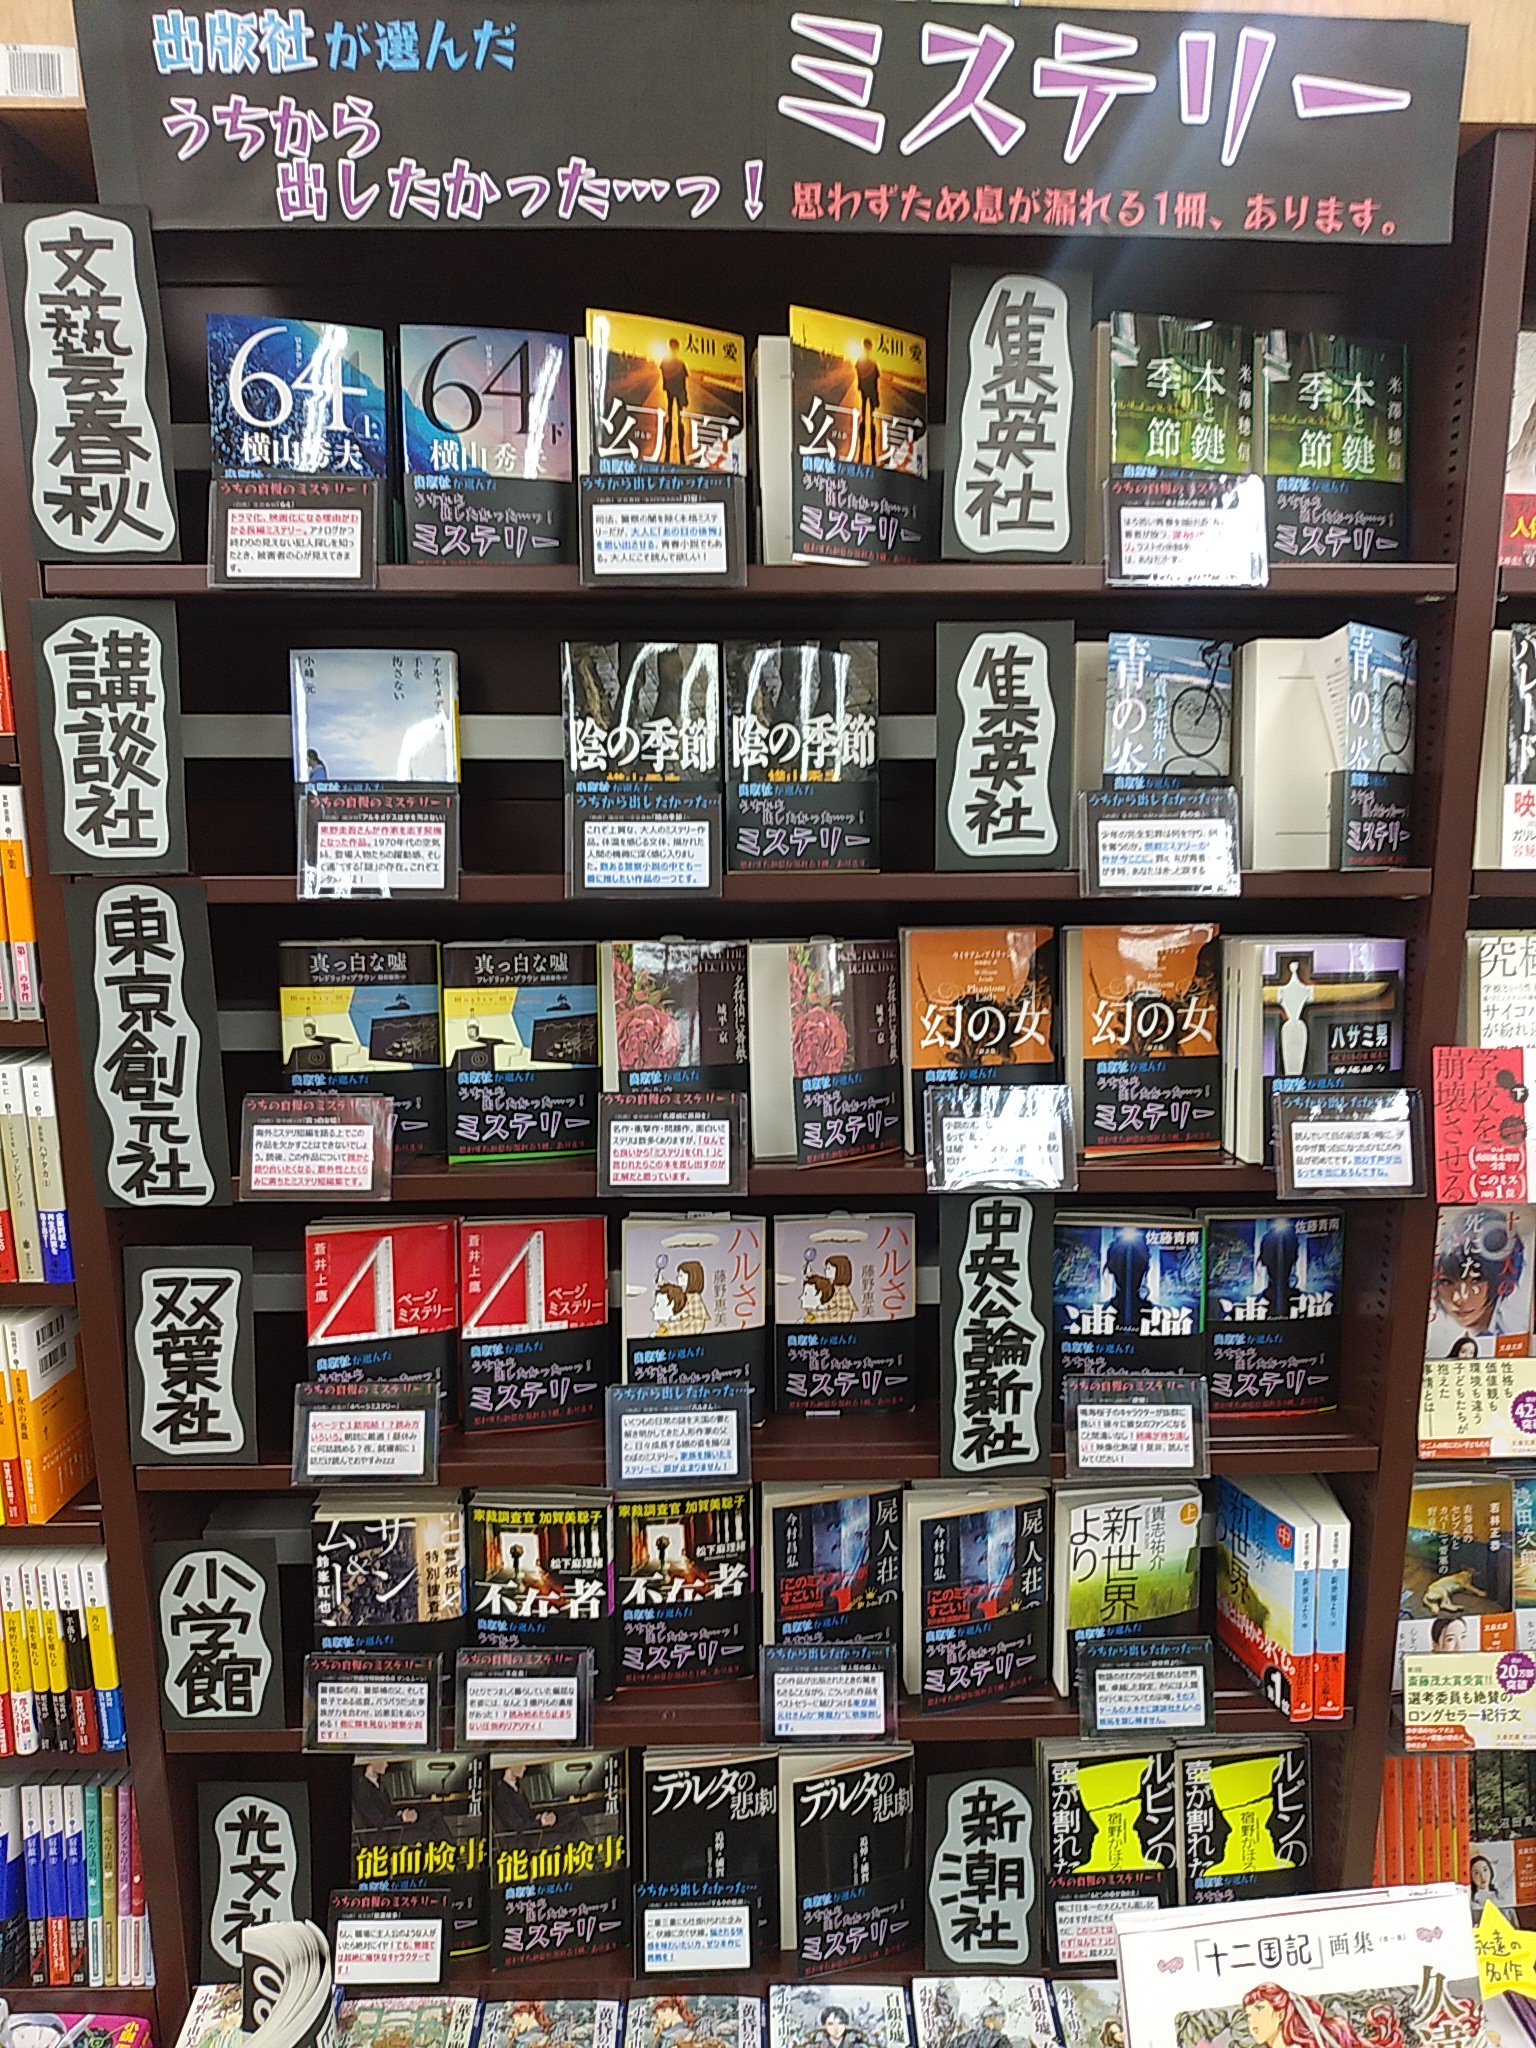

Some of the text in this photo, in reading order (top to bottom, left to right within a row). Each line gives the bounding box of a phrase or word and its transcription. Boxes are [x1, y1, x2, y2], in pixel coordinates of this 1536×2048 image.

[152, 9, 517, 73] 出版社が選んだ
[778, 12, 1412, 166] ミステリー
[162, 95, 380, 160] うちから
[40, 226, 164, 545] 文藝春秋
[422, 335, 535, 434] 64
[965, 288, 1058, 536] 集英社
[413, 523, 560, 559] ミステリー
[800, 505, 922, 549] ミステリー
[1273, 523, 1399, 559] ミステリー
[54, 627, 161, 850] 講談社
[570, 716, 717, 773] 陰の季節
[732, 714, 876, 768] 陰の季節
[966, 645, 1045, 845] 集英社
[736, 826, 871, 857] ミステリー
[309, 952, 409, 976] 真っ白な嘘
[474, 952, 570, 976] 真っ白な嘘
[919, 1001, 1050, 1050] 幻の女
[1091, 996, 1217, 1046] 幻の女
[1330, 1023, 1389, 1049] ハサミ男
[103, 894, 206, 1198] 東京創元社
[1093, 1101, 1216, 1132] ミステリー
[1467, 1049, 1500, 1145] 学校を
[455, 1111, 591, 1143] ミステリー
[802, 1109, 900, 1149] ミステリー
[1435, 1047, 1468, 1203] 崩壊させる
[1452, 1211, 1484, 1302] 死にたい
[397, 1304, 454, 1323] ミステリー
[398, 1288, 438, 1306] ページ
[548, 1298, 603, 1316] ミステリー
[549, 1283, 588, 1301] ページ
[960, 1200, 1038, 1464] 中央公論新社
[152, 1276, 234, 1445] 双葉社
[469, 1378, 598, 1413] ミステリー
[786, 1370, 909, 1397] ミステリー
[1209, 1371, 1330, 1398] ミステリー
[1070, 1509, 1100, 1583] より
[1149, 1506, 1166, 1572] 貴志祐介
[618, 1563, 748, 1605] 不在者
[1102, 1505, 1142, 1623] 新世界
[474, 1578, 606, 1619] 不在者
[170, 1556, 263, 1715] 小学館
[622, 1640, 745, 1671] ミステリー
[924, 1653, 1037, 1691] ミステリー
[1406, 1691, 1514, 1706] 選考委員も絶賛の
[1406, 1706, 1522, 1723] ロングセラー紀行文
[1141, 1751, 1176, 1868] ルビンの
[1273, 1753, 1307, 1868] ルビンの
[356, 1839, 486, 1881] 能面検事
[497, 1836, 626, 1883] 能面検事
[938, 1786, 1026, 1952] 新潮社
[501, 1919, 622, 1952] ミステリー
[802, 1921, 911, 1963] ミステリー
[1485, 1959, 1523, 1983] 名作
